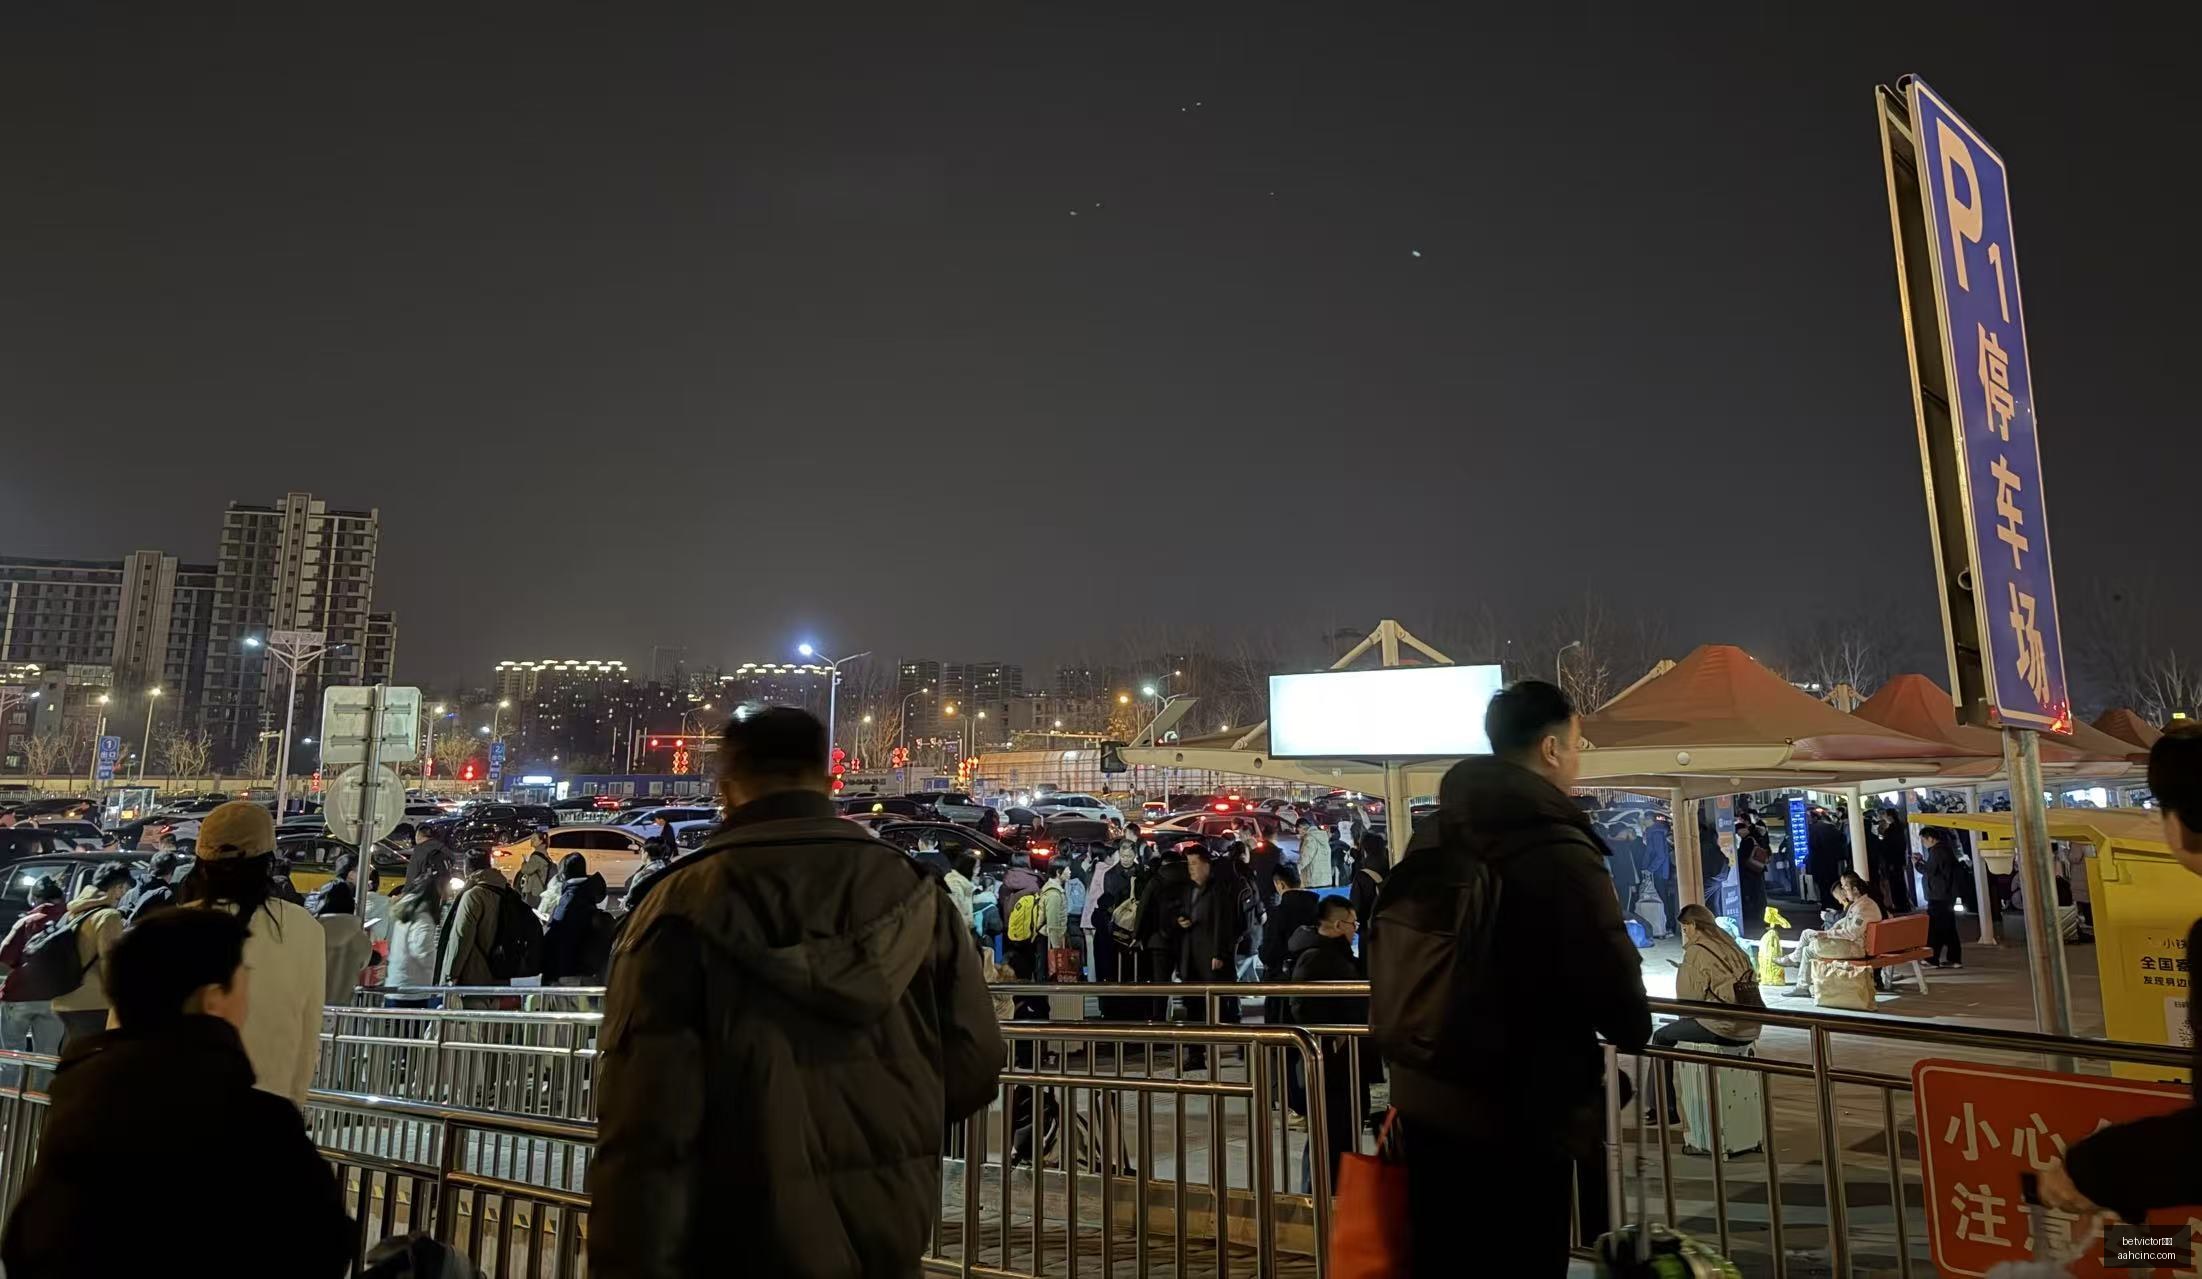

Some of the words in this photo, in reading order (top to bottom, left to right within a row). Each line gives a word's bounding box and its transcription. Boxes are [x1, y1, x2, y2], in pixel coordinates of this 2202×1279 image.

[1936, 117, 2010, 324] P1
[1977, 322, 2050, 704] 停车场
[1944, 1102, 2112, 1171] 小心
